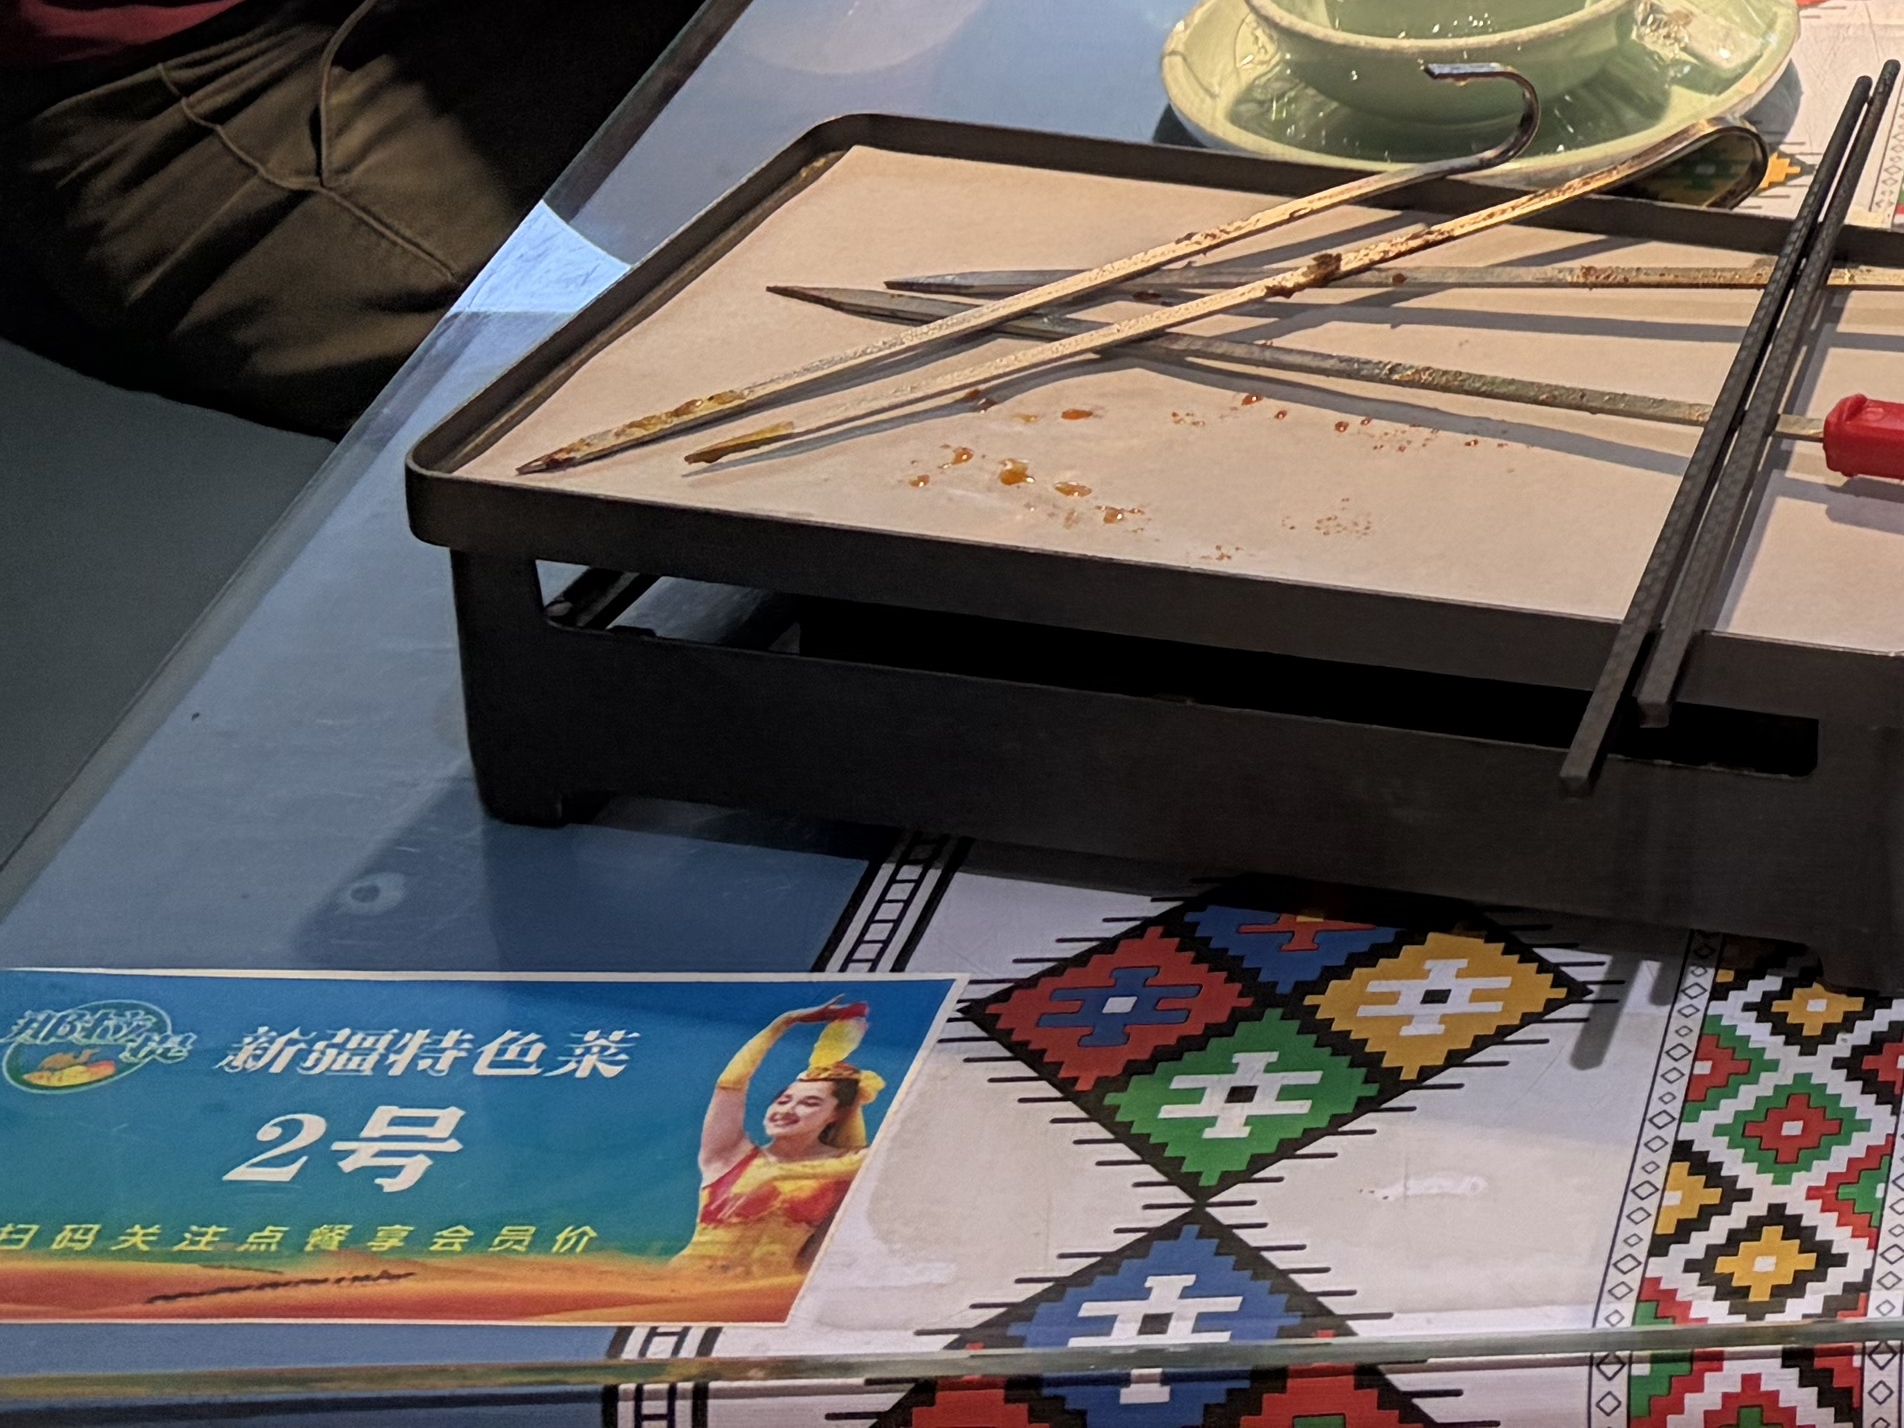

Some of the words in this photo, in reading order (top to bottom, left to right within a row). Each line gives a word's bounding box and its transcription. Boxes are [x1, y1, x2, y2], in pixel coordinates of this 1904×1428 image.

[213, 1025, 642, 1080] 新疆特色菜
[223, 1105, 466, 1193] 2号
[0, 1223, 600, 1253] 扫码关注点餐享会员价
